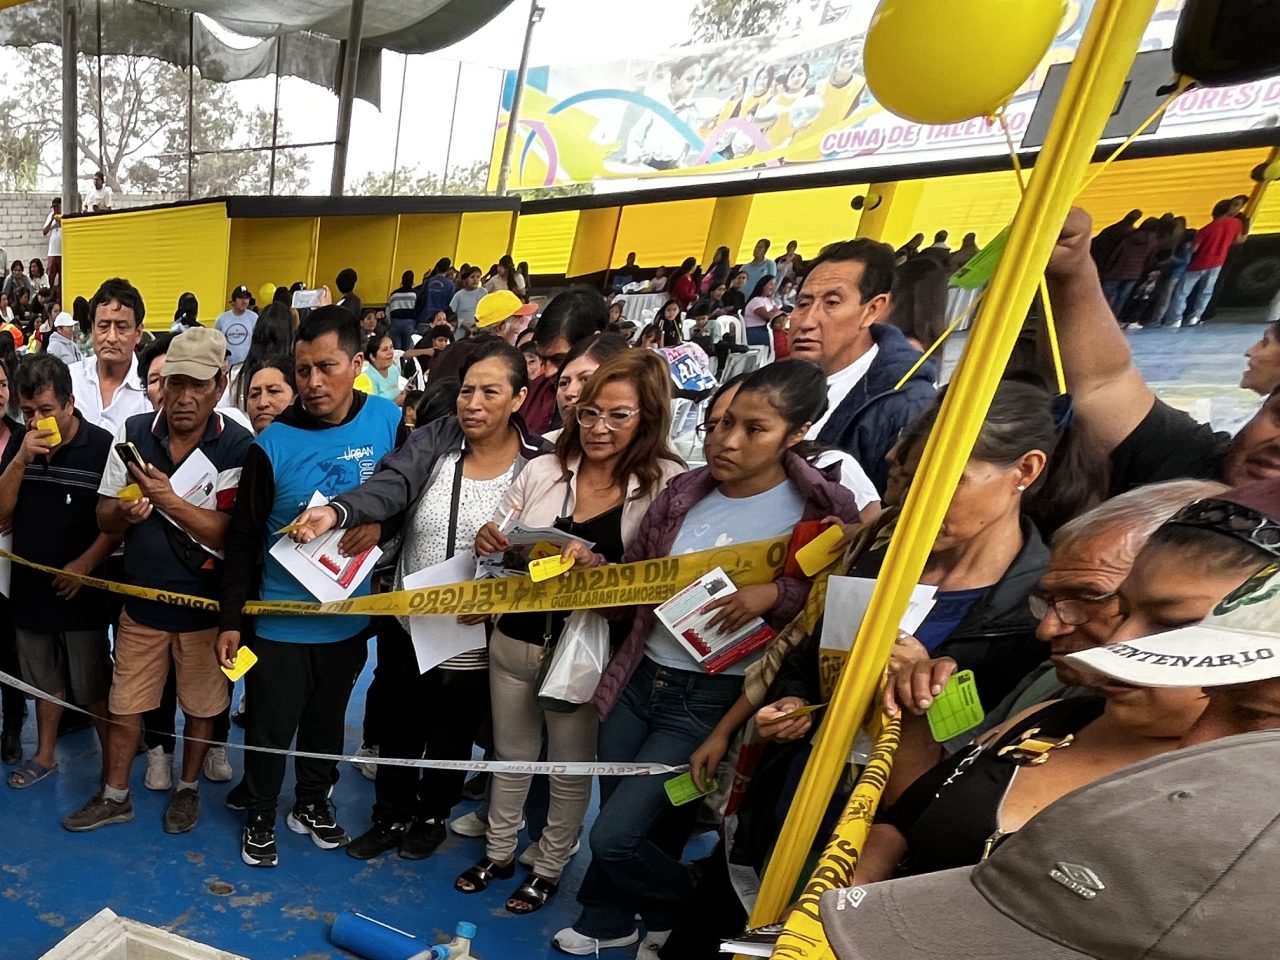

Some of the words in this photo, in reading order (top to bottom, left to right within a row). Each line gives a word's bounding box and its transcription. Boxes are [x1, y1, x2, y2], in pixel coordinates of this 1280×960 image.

[822, 128, 880, 150] CUNA
[887, 124, 916, 144] DE
[336, 446, 374, 462] URBAN
